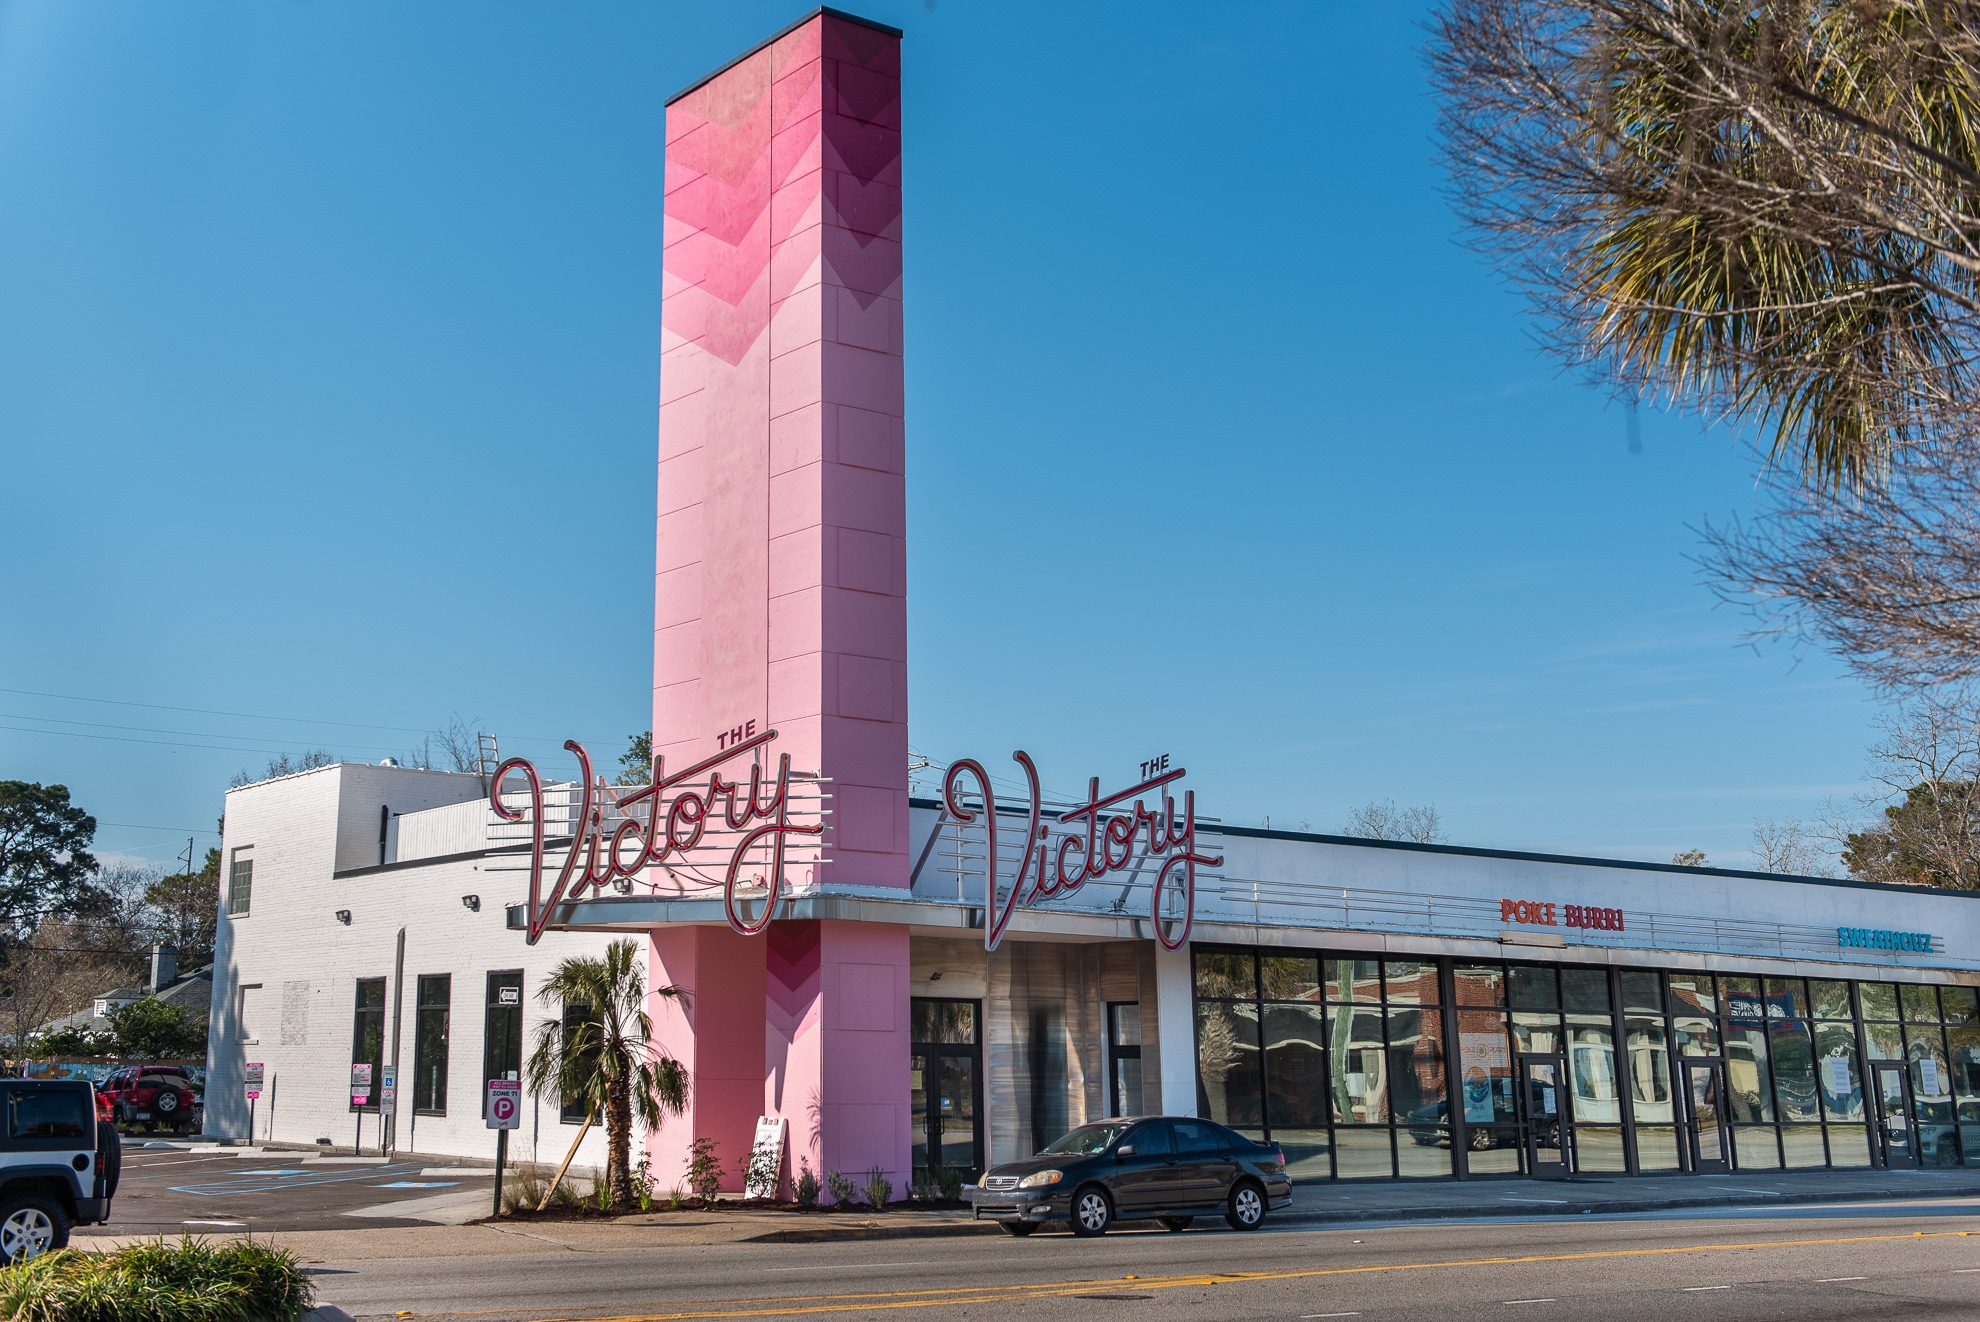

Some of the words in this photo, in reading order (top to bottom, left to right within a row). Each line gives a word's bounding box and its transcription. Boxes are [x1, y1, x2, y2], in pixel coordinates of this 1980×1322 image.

[716, 718, 756, 750] THE
[1139, 753, 1170, 777] THE
[489, 729, 826, 946] Victory
[942, 750, 1224, 951] Victory
[1500, 898, 1558, 926] POKE
[1564, 904, 1625, 931] BURRI
[1838, 926, 1934, 953] SWEATHOUZ
[498, 1100, 511, 1117] P
